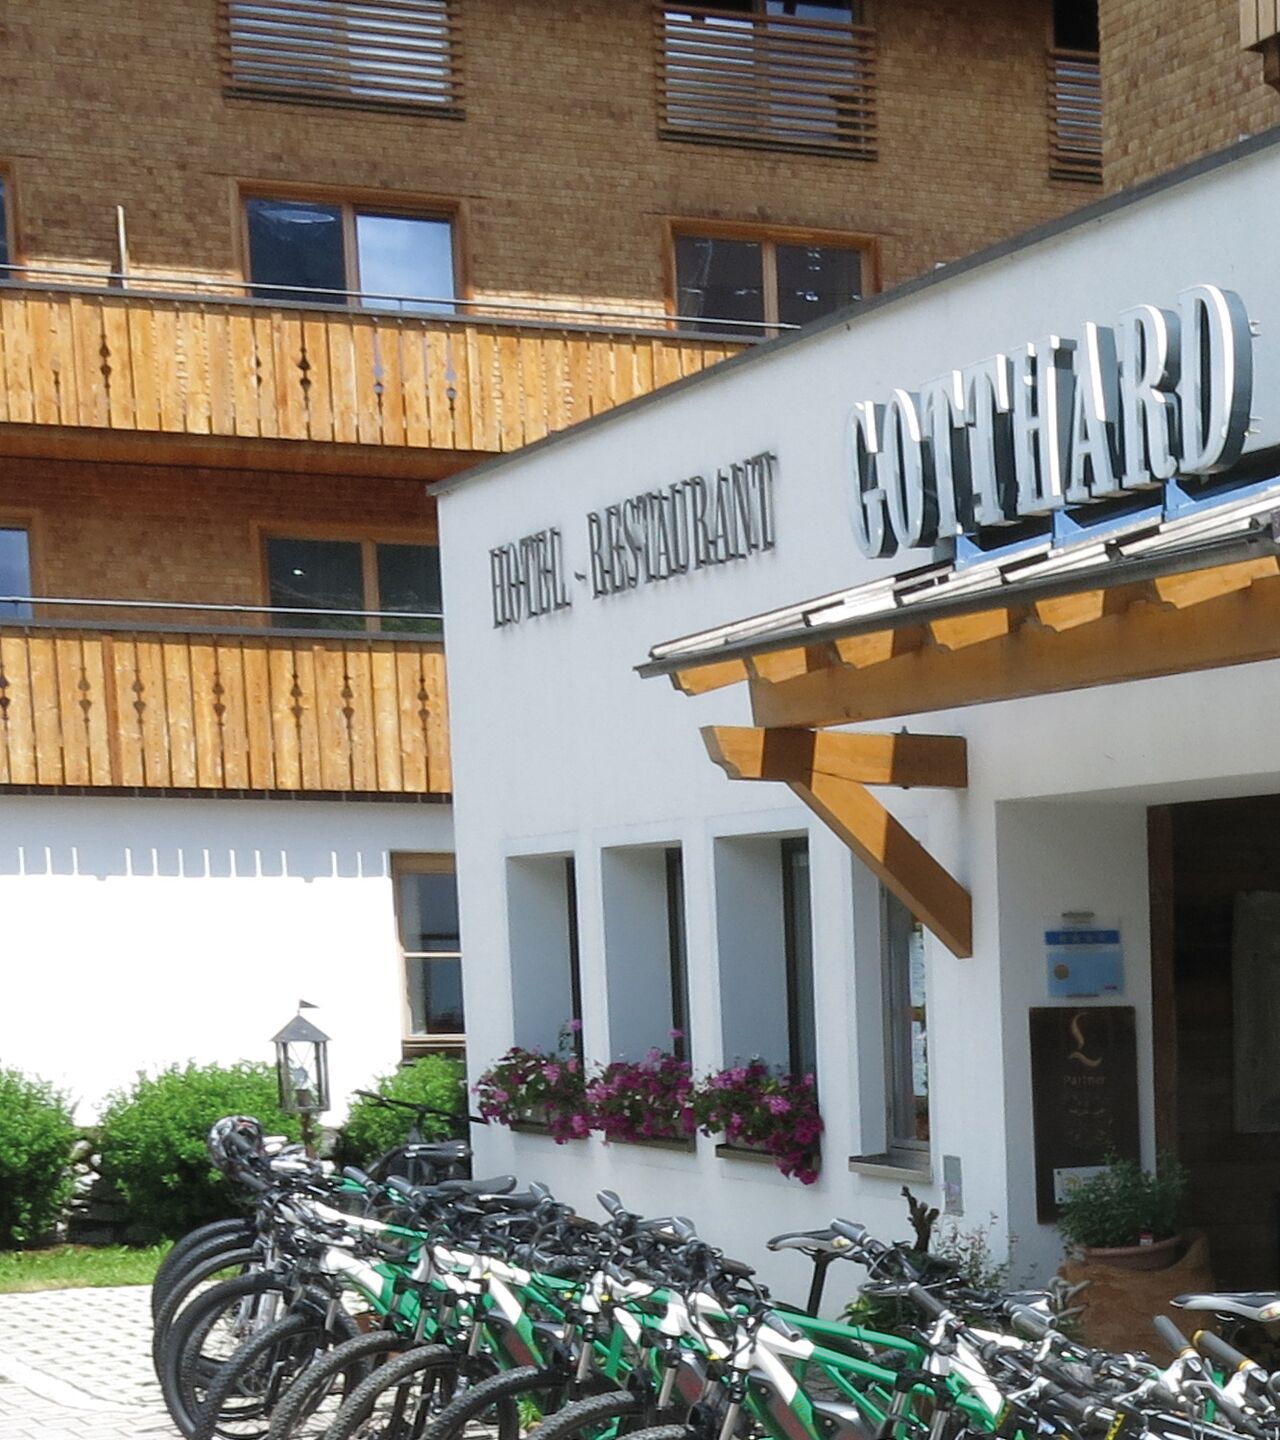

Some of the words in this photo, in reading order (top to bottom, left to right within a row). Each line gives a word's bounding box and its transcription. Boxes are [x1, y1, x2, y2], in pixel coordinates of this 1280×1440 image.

[845, 284, 1253, 560] GOTTHARD
[489, 526, 573, 629] HOTEL
[586, 450, 778, 600] RESTAURANT
